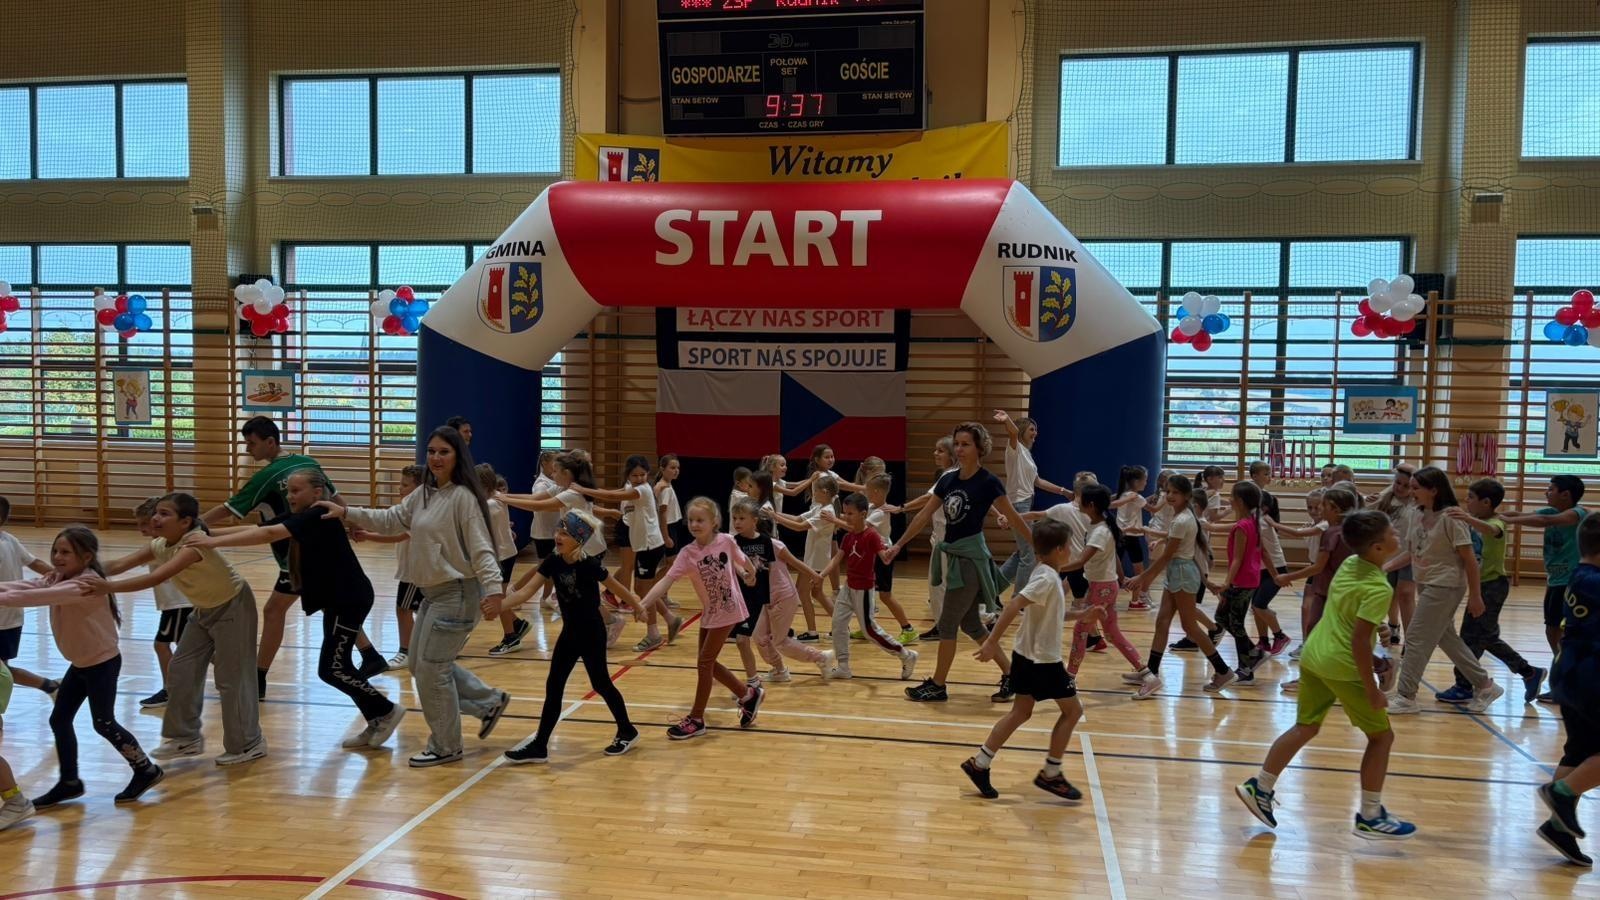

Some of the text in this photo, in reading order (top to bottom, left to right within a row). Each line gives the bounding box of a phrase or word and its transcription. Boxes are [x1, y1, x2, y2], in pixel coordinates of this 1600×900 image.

[770, 57, 808, 66] POŁOWA
[781, 67, 797, 76] SET
[840, 57, 889, 80] GOŚCIE
[671, 65, 760, 84] GOSPODARZE
[671, 97, 690, 105] STAN
[766, 94, 823, 118] 9:37
[862, 92, 882, 100] STAN
[759, 121, 778, 129] CZAS
[788, 120, 807, 128] CZAS
[768, 145, 893, 179] Witamy
[654, 209, 882, 267] START
[486, 240, 546, 259] GMINA
[998, 242, 1078, 264] RUDNIK
[687, 309, 884, 330] ŁĄCZY NAS SPORT
[688, 345, 887, 367] SPORT NÁS SPOJUJE
